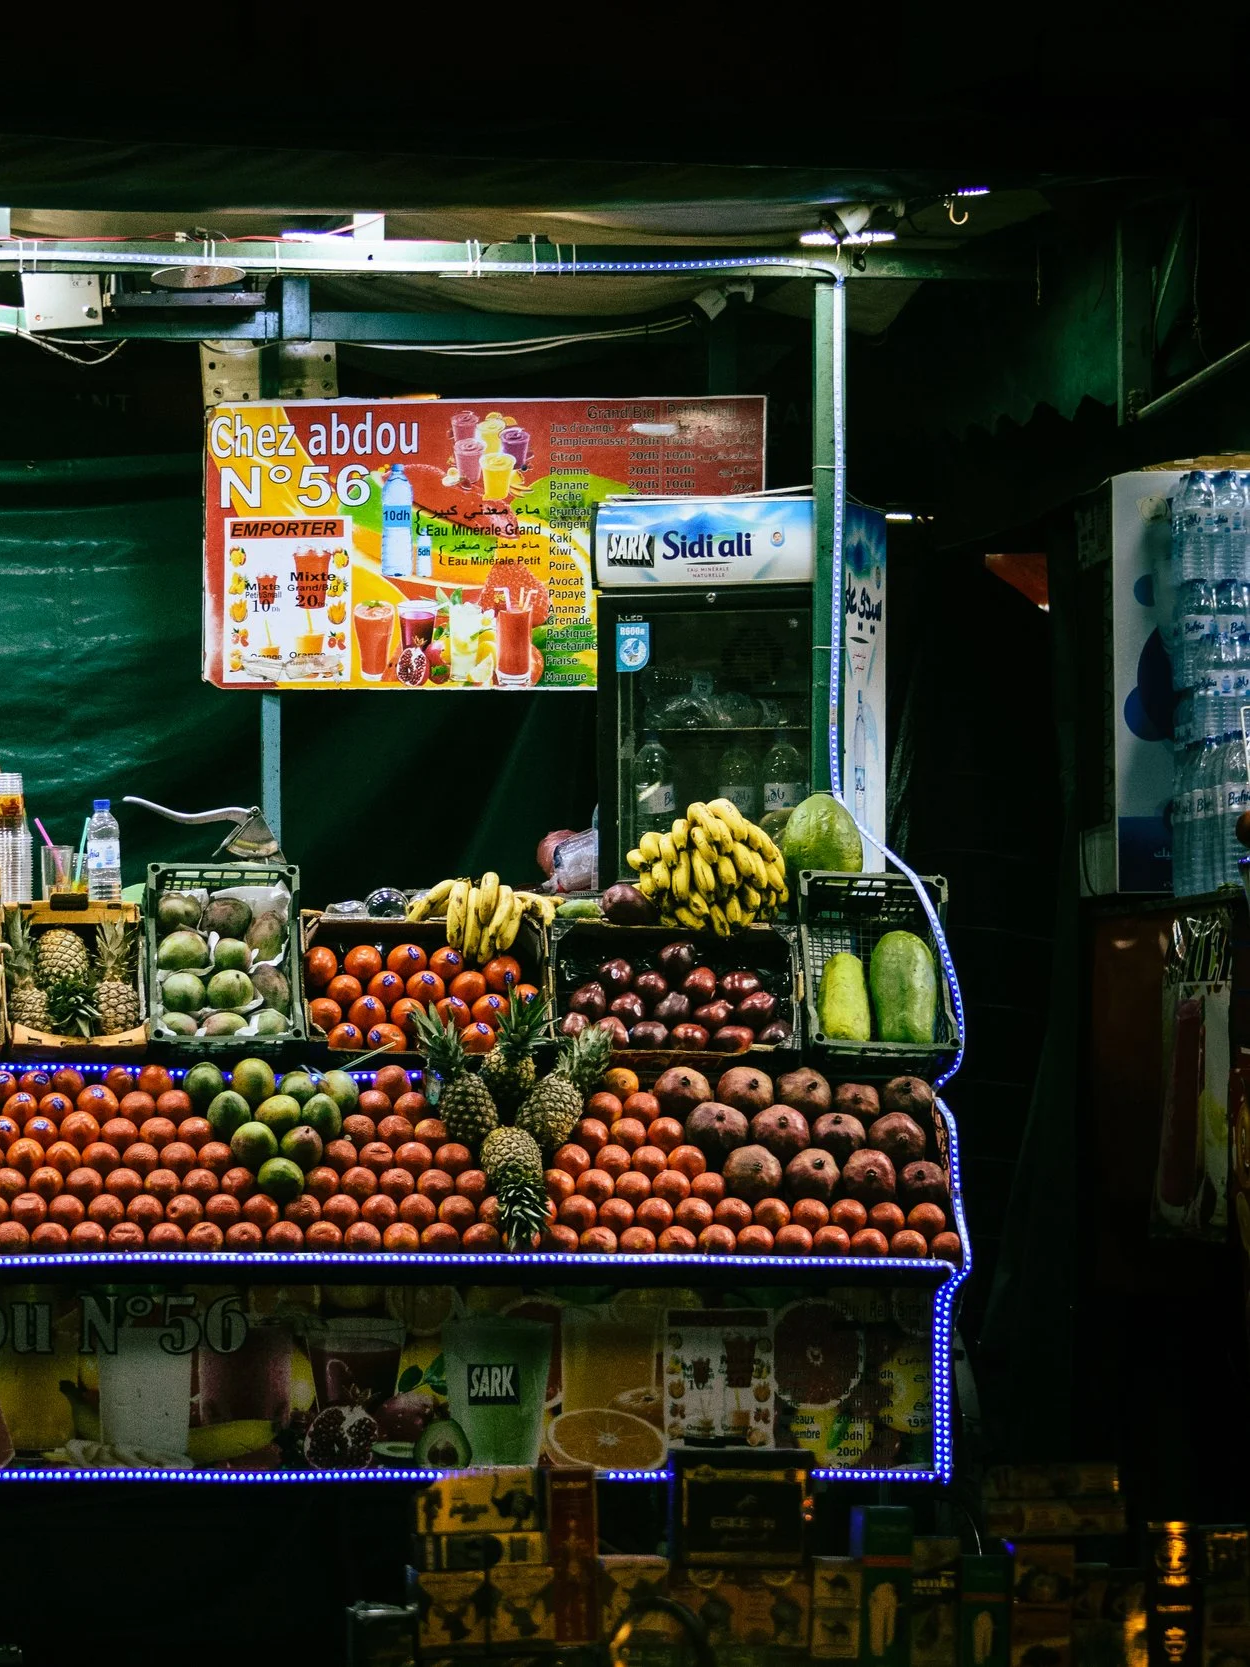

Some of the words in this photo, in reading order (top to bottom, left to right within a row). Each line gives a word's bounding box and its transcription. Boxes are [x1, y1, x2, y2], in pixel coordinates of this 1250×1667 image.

[210, 414, 297, 458] Chez
[307, 411, 420, 456] abdou
[551, 423, 567, 434] Jus
[569, 423, 614, 435] d'orange
[550, 437, 627, 448] Pamplemousse
[629, 437, 660, 446] 20dh
[550, 452, 582, 462] Citron
[628, 452, 659, 461] 20dh
[550, 467, 590, 476] Pomme
[628, 467, 659, 475] 20dh
[664, 467, 696, 475] 10dh
[219, 464, 372, 509] N°56
[550, 481, 589, 490] Banane
[628, 481, 659, 489] 20dh
[664, 481, 695, 489] 10dh
[550, 491, 582, 501] Peche
[383, 510, 410, 521] 10dh
[431, 504, 457, 519] كبير
[463, 505, 508, 520] معدني
[515, 505, 540, 516] ماء
[231, 521, 337, 537] EMPORTER
[426, 525, 448, 537] Eau
[452, 524, 501, 536] Minérale
[505, 523, 541, 535] Grand
[549, 533, 572, 543] Kaki
[450, 540, 480, 553] صغير
[483, 541, 516, 553] معدني
[521, 540, 540, 549] ماء
[608, 533, 652, 560] SARK
[662, 530, 714, 560] Sidi
[718, 532, 752, 557] ali
[417, 548, 431, 557] 5dh
[549, 546, 572, 556] Kiwi
[447, 556, 468, 566] Eau
[470, 555, 514, 566] Minérale
[517, 555, 541, 565] Petit
[549, 562, 576, 571] Poire
[290, 571, 336, 582] Mixte
[548, 576, 584, 586] Avocat
[246, 583, 281, 591] Mixte
[287, 584, 339, 592] Grand/Big
[548, 589, 587, 600] Papaye
[252, 599, 271, 613] 10
[295, 594, 318, 607] 20
[547, 605, 587, 614] Ananas
[547, 615, 591, 625] Grenade
[546, 629, 592, 640] Pastique
[546, 641, 597, 651] Nectarine
[546, 656, 578, 665] Fraise
[544, 672, 587, 683] Mangue
[76, 1294, 249, 1355] N°56
[468, 1367, 516, 1400] SARK
[836, 1430, 863, 1441] 20dh
[836, 1446, 863, 1457] 20dh
